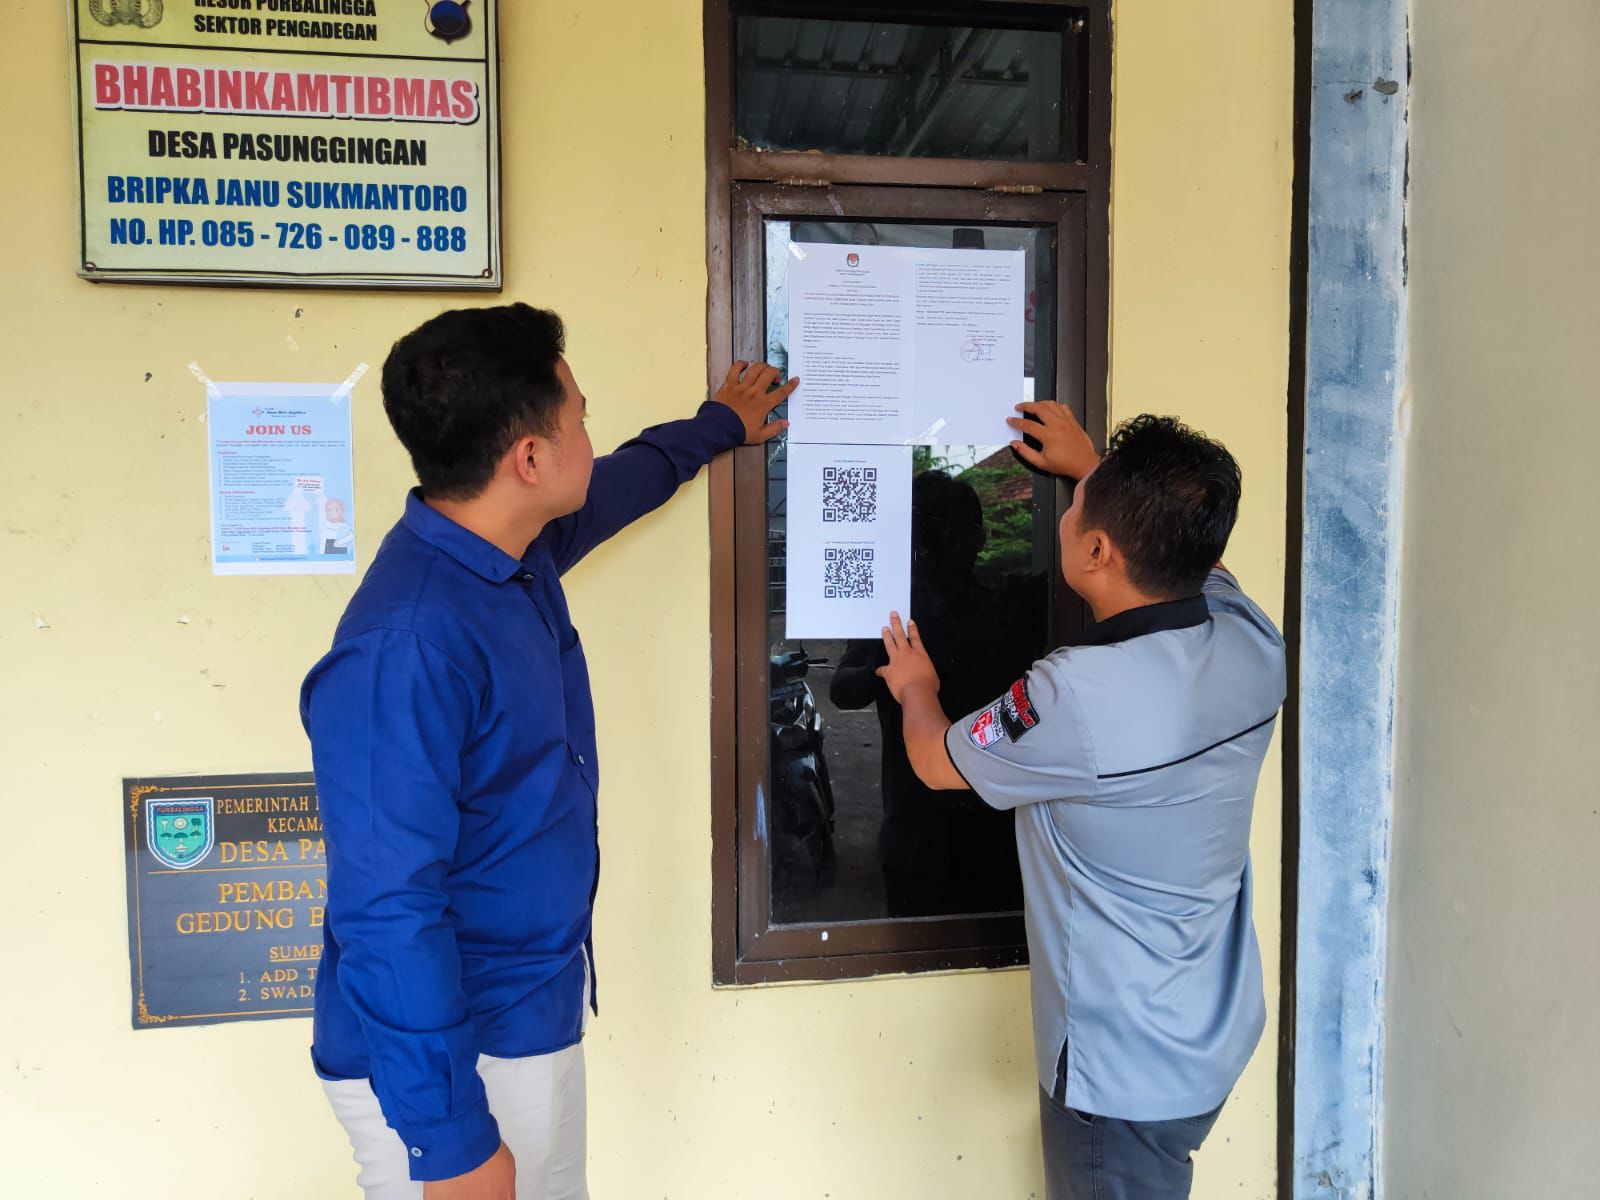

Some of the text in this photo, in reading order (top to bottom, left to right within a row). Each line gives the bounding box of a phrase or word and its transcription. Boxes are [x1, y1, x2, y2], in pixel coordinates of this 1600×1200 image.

[194, 15, 377, 41] SEKTOR PENGADEGAN
[94, 63, 477, 119] BHABINKAMTIBMAS
[148, 129, 427, 166] DESA PASUNGGINGAN
[107, 175, 468, 213] BRIPKA JANU SUKMANTORO
[110, 218, 153, 245] NO.
[158, 219, 196, 246] HP.
[202, 220, 255, 248] 085
[275, 222, 323, 250] 726
[344, 224, 396, 251] 089
[416, 225, 467, 252] 888
[246, 424, 312, 435] JOIN US
[216, 796, 309, 815] PEMERINTAH
[268, 817, 323, 833] KECAM
[219, 839, 289, 864] DESA
[176, 907, 294, 934] GEDUNG
[270, 943, 323, 960] SUMB
[260, 968, 298, 983] ADD
[238, 984, 315, 1002] 2. SWAD
